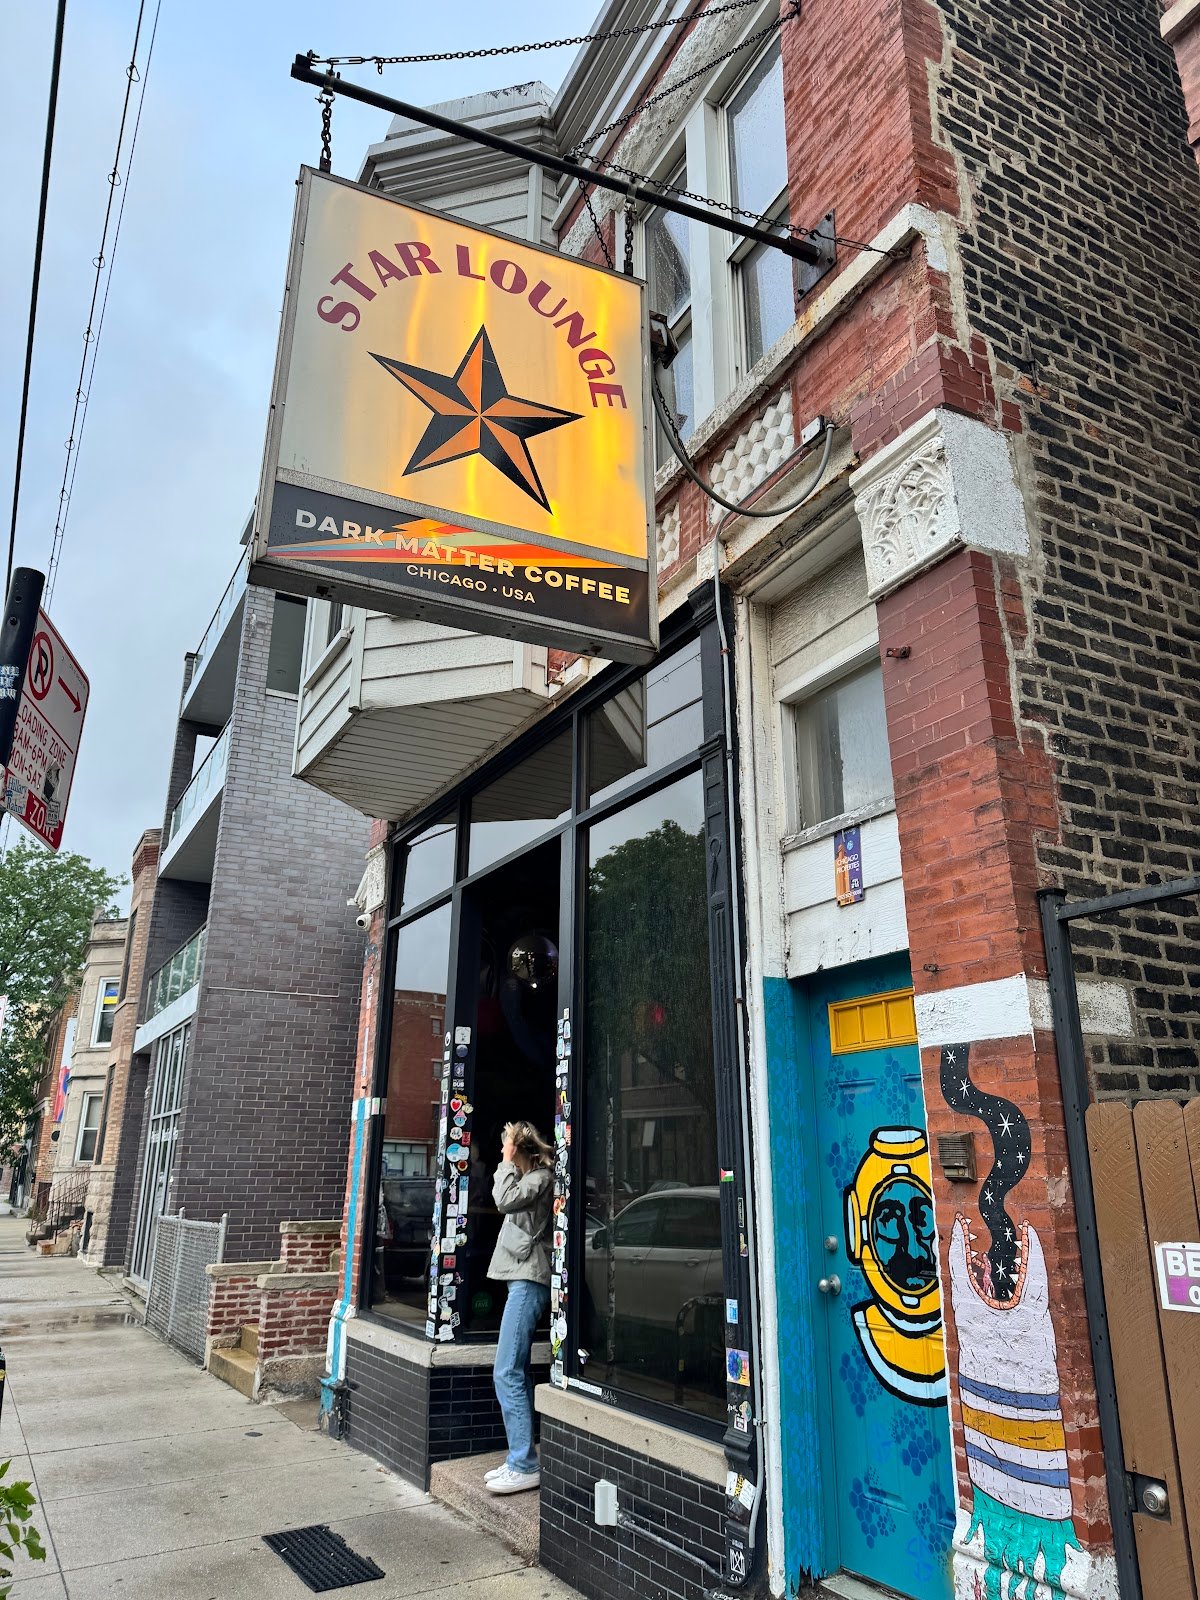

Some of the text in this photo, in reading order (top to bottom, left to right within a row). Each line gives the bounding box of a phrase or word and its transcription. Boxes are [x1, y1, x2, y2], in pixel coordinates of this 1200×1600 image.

[317, 241, 627, 409] STAR LOUNGE
[295, 508, 631, 605] DARK MATTER COFFEE
[406, 564, 536, 604] CHICAGO USA
[13, 722, 48, 771] 8AM-6PM
[17, 704, 66, 769] OADING ZONE
